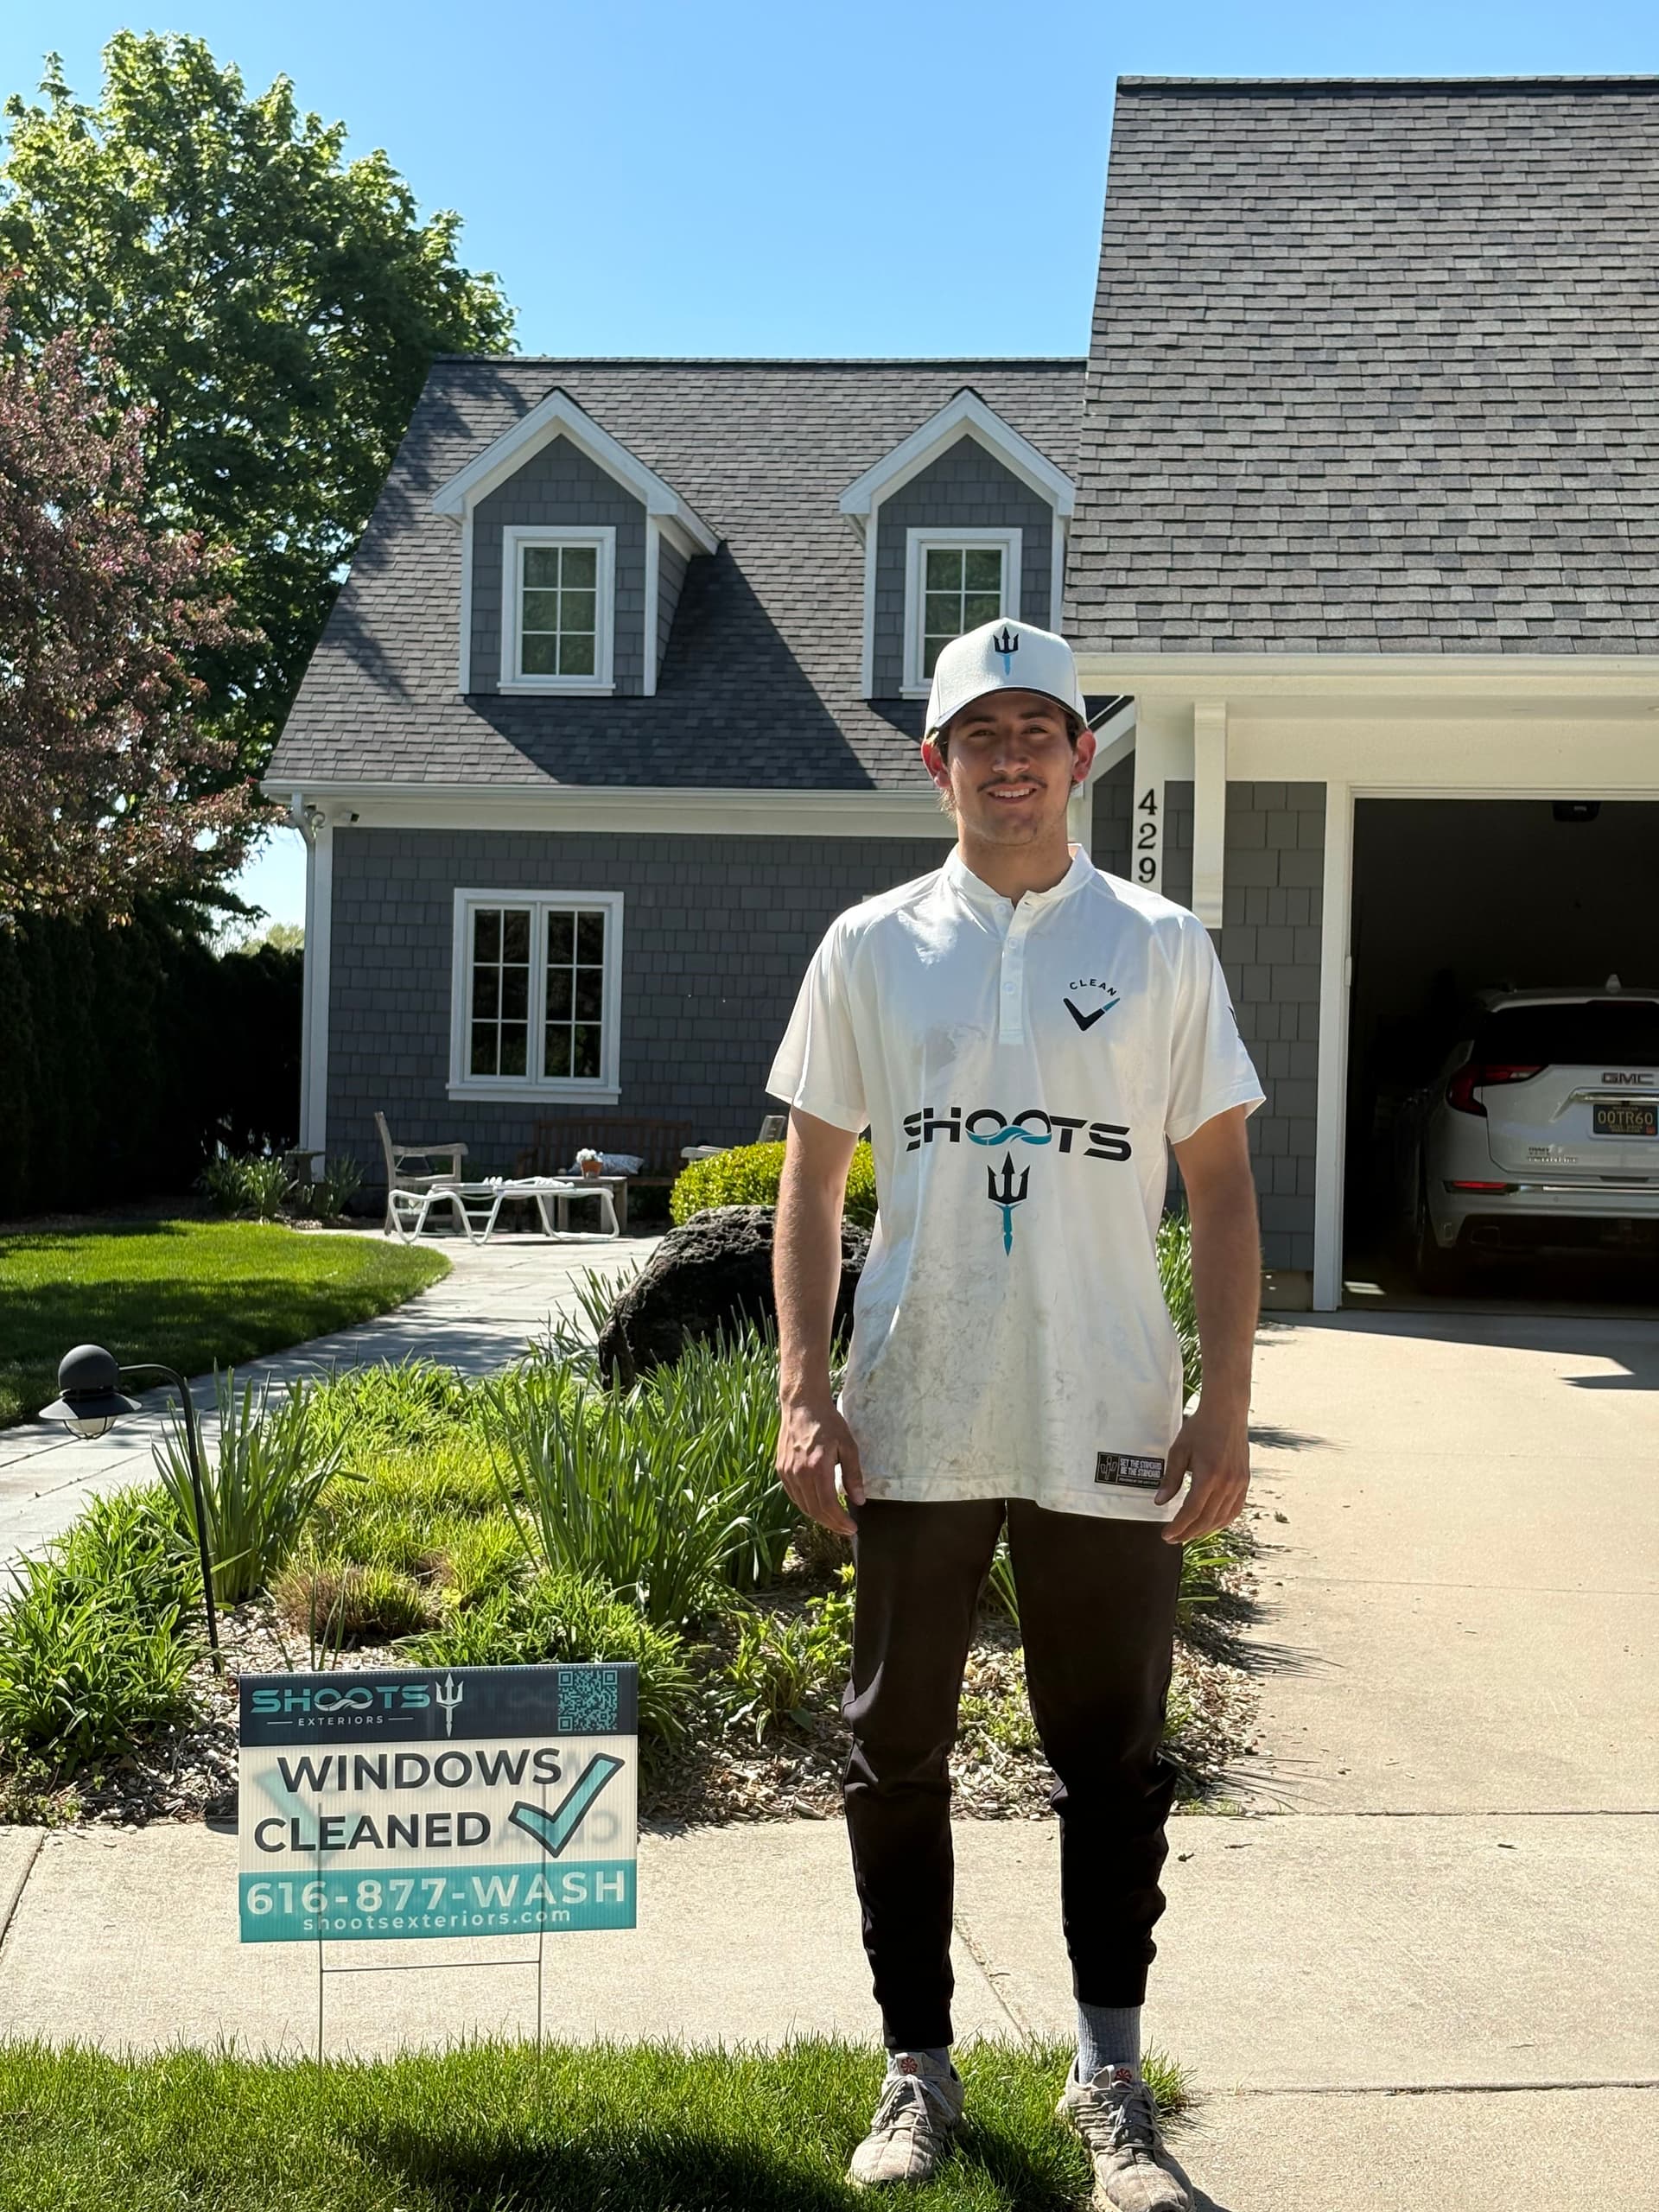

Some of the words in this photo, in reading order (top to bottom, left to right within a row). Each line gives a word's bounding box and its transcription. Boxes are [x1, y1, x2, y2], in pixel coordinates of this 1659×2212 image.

[1137, 788, 1158, 883] 429
[1070, 978, 1116, 996] CLEAN
[1602, 1072, 1654, 1085] GMC
[1120, 1459, 1128, 1467] SET
[251, 1684, 430, 1713] SHOOTS
[298, 1715, 384, 1726] EXTERIORS
[276, 1748, 562, 1793] WINDOWS
[254, 1812, 492, 1853] CLEANED
[246, 1870, 626, 1915] 616-877-WASH
[303, 1907, 570, 1930] shootsexteriors.com
